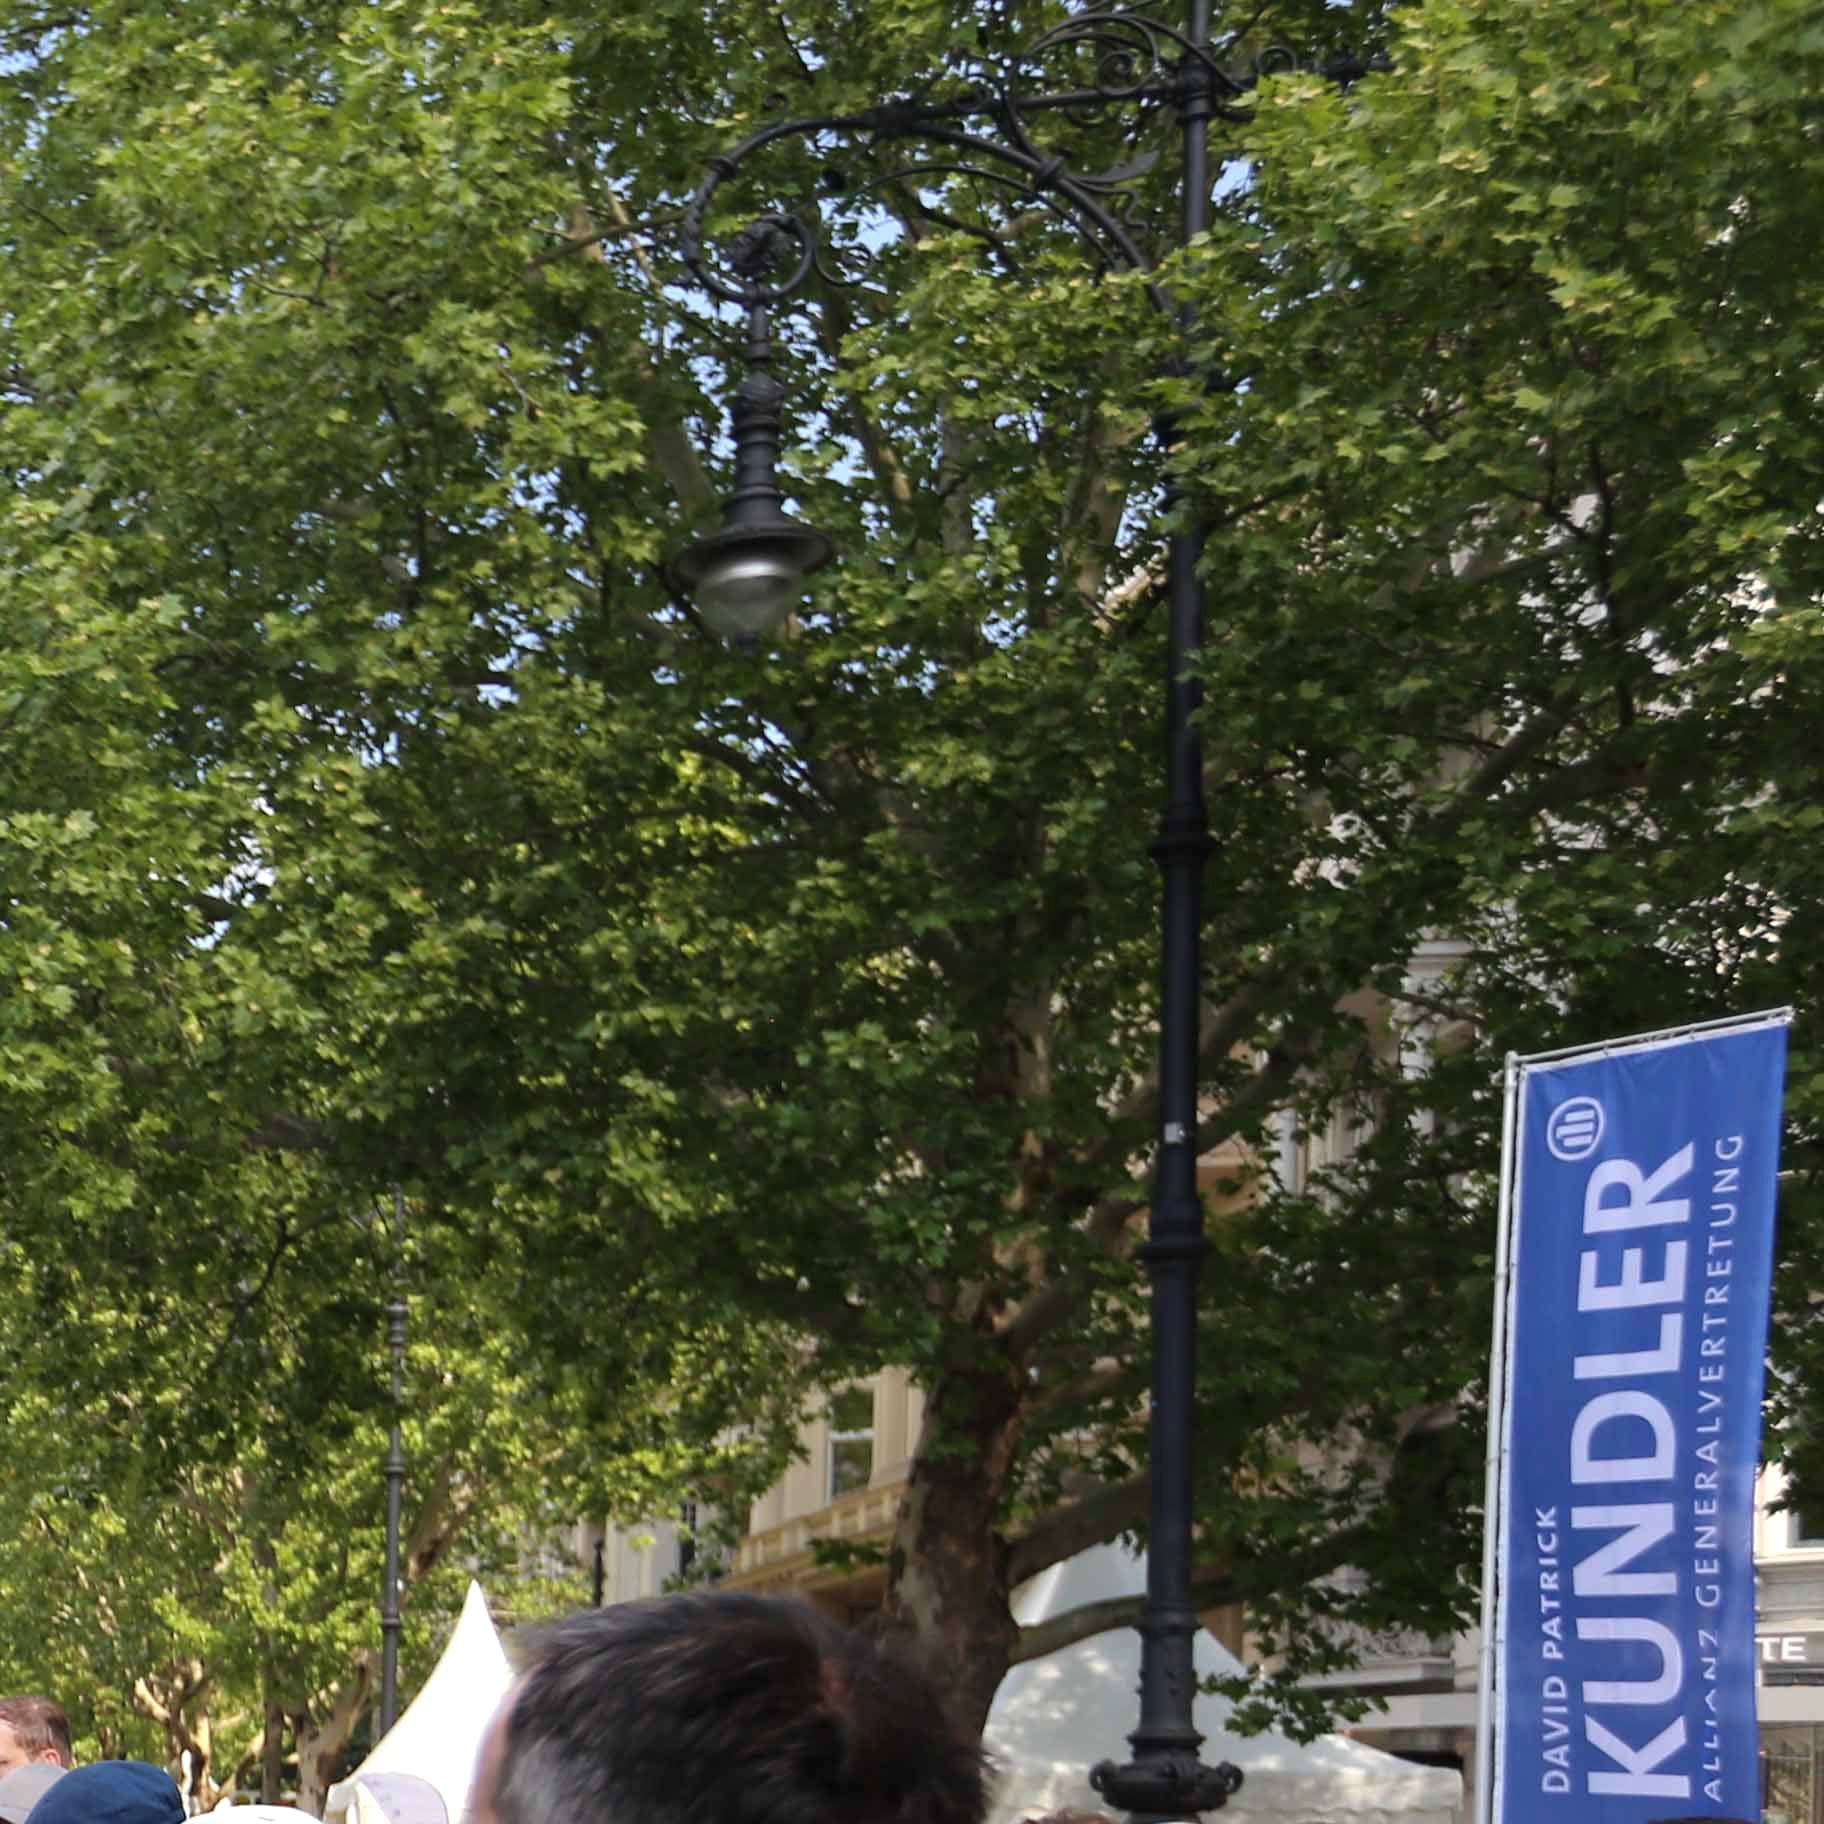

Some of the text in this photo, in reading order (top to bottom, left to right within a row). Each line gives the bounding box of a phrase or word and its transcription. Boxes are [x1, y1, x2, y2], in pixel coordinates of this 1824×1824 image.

[1570, 1142, 1694, 1798] KUNDLER
[1695, 1135, 1743, 1607] GENERALVERTRETUNG
[1536, 1506, 1569, 1793] DAVID PATRICK
